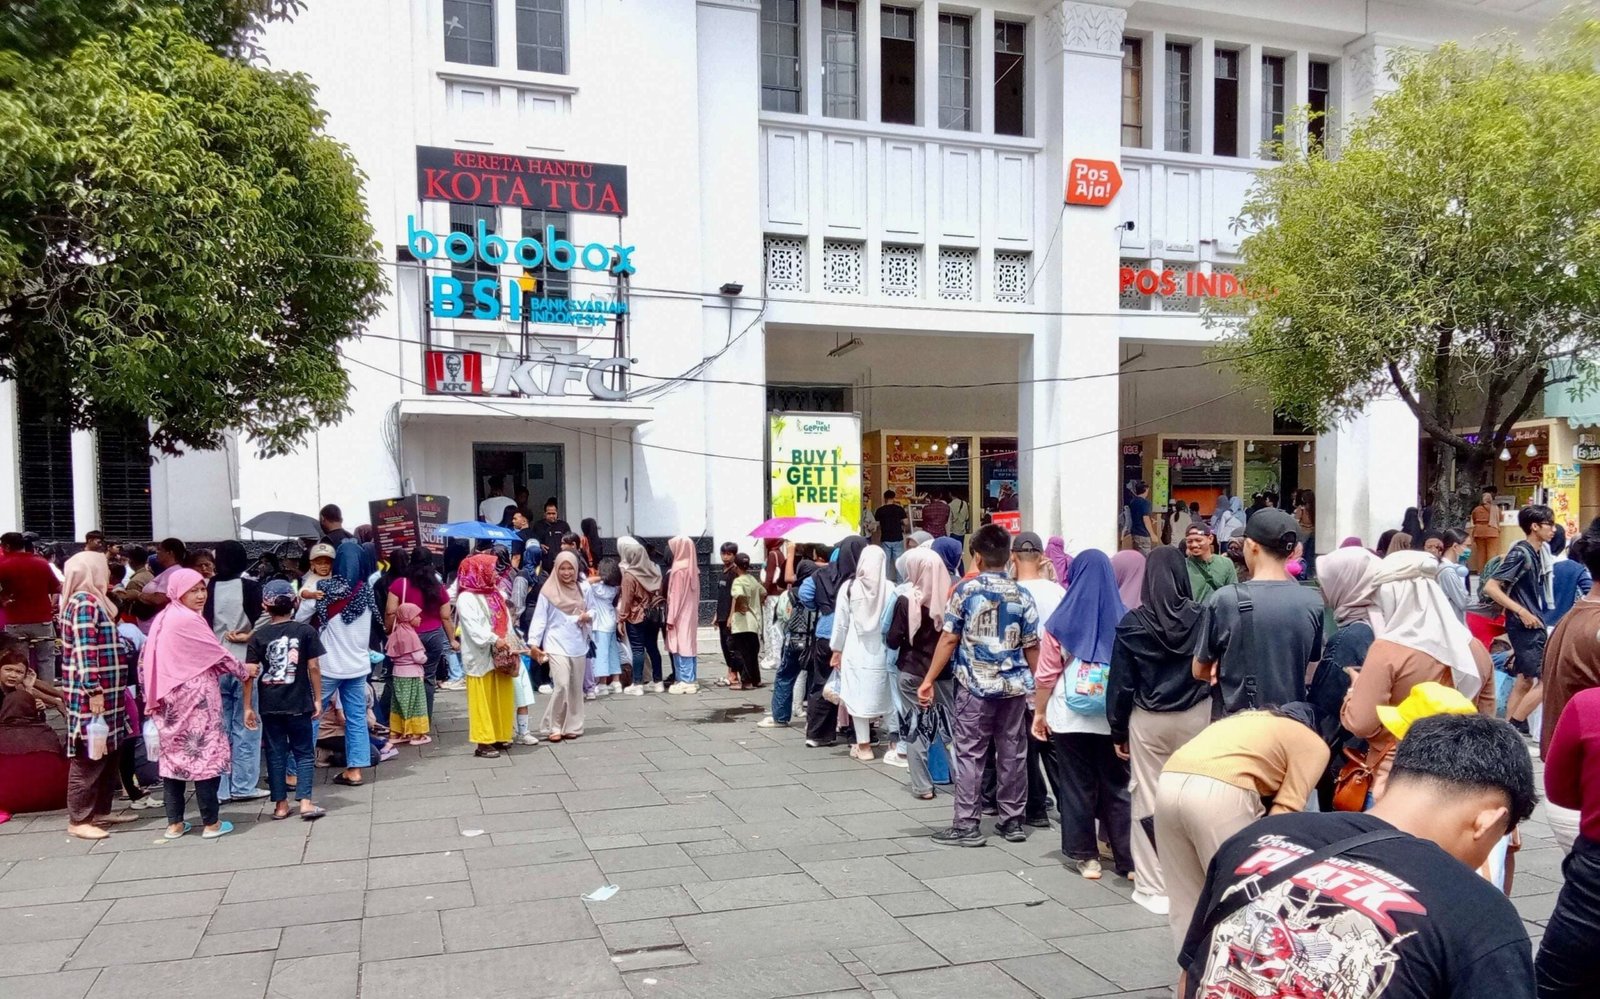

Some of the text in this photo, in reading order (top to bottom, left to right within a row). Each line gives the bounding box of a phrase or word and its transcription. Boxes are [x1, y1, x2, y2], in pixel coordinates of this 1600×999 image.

[453, 151, 593, 178] KERETA HANTU
[1075, 163, 1109, 182] Pos
[423, 168, 623, 213] KOTA TUA
[1075, 180, 1111, 200] Aja!
[407, 214, 635, 275] bobobox
[1119, 266, 1177, 297] POS
[432, 275, 522, 321] BSI
[529, 297, 629, 315] BANK SYARIAH
[530, 310, 607, 327] INDONESIA
[490, 351, 631, 400] KFC
[442, 381, 467, 391] KFC
[791, 449, 838, 466] BUY 1
[786, 466, 838, 486] GET 1
[796, 486, 838, 503] FREE
